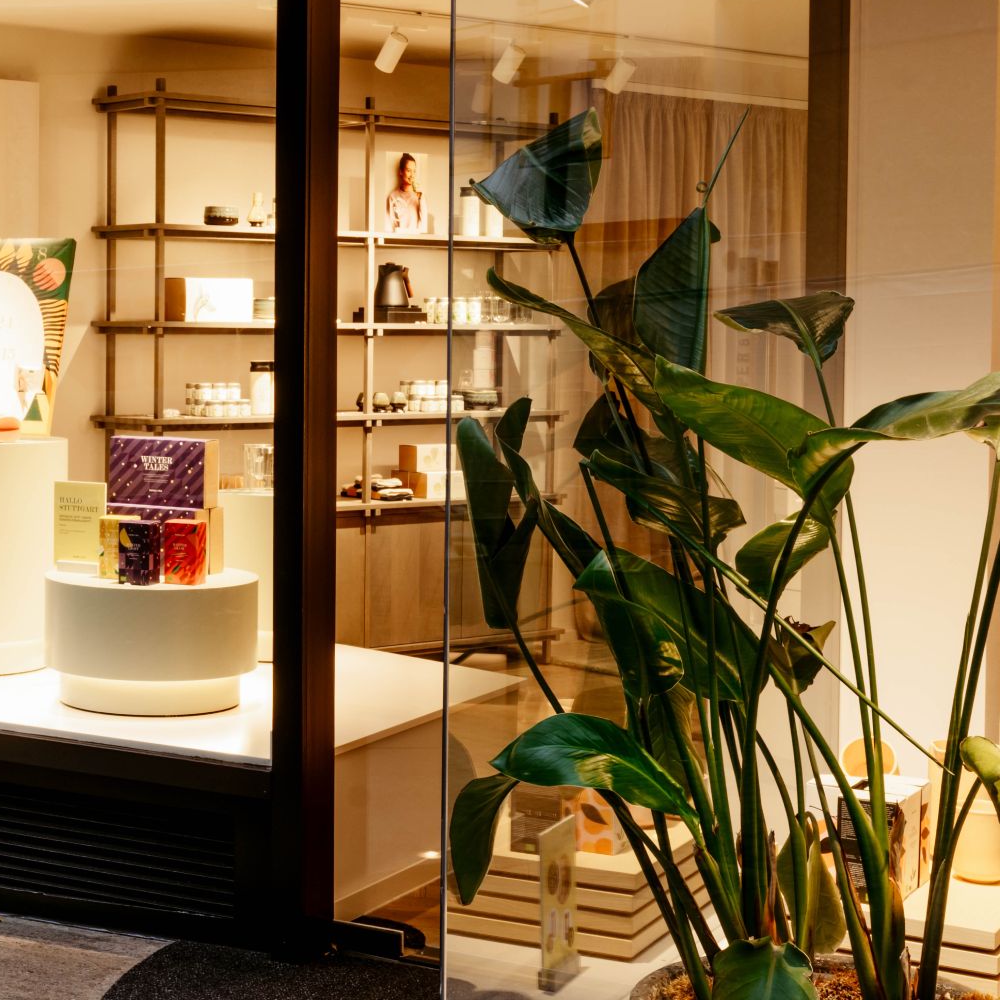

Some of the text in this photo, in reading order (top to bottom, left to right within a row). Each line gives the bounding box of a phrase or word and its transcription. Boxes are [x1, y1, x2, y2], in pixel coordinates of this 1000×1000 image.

[140, 455, 173, 465] WINTER
[143, 463, 169, 471] TALES
[59, 496, 83, 504] HALLO
[59, 504, 98, 513] STUTTGART
